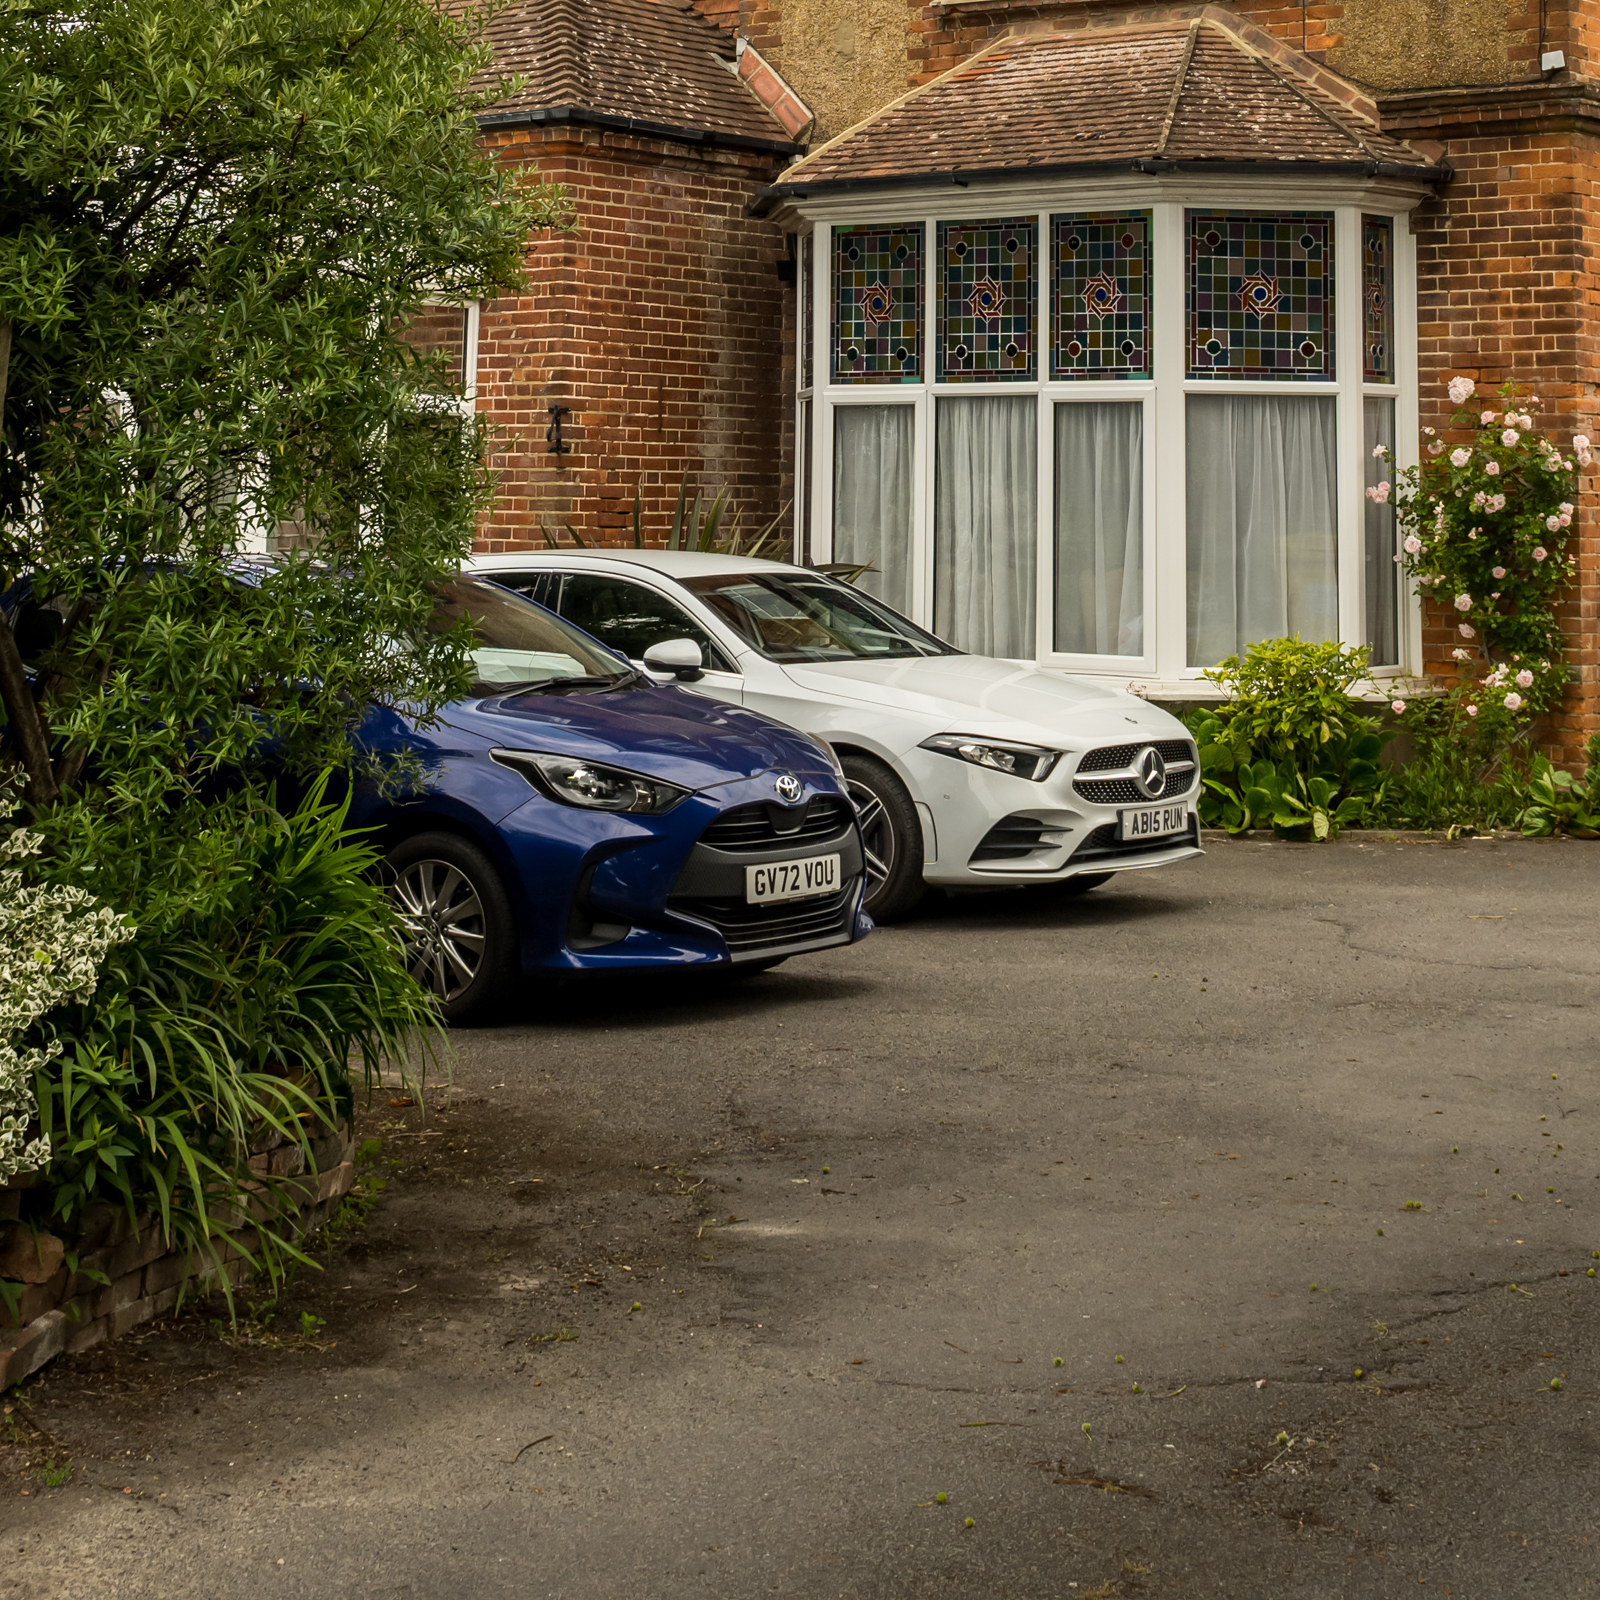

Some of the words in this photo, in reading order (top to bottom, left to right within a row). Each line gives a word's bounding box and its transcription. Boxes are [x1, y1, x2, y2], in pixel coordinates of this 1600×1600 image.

[1132, 811, 1160, 835] AB15
[1163, 807, 1183, 831] RUN
[755, 865, 800, 896] GV72
[805, 859, 834, 888] VOU
